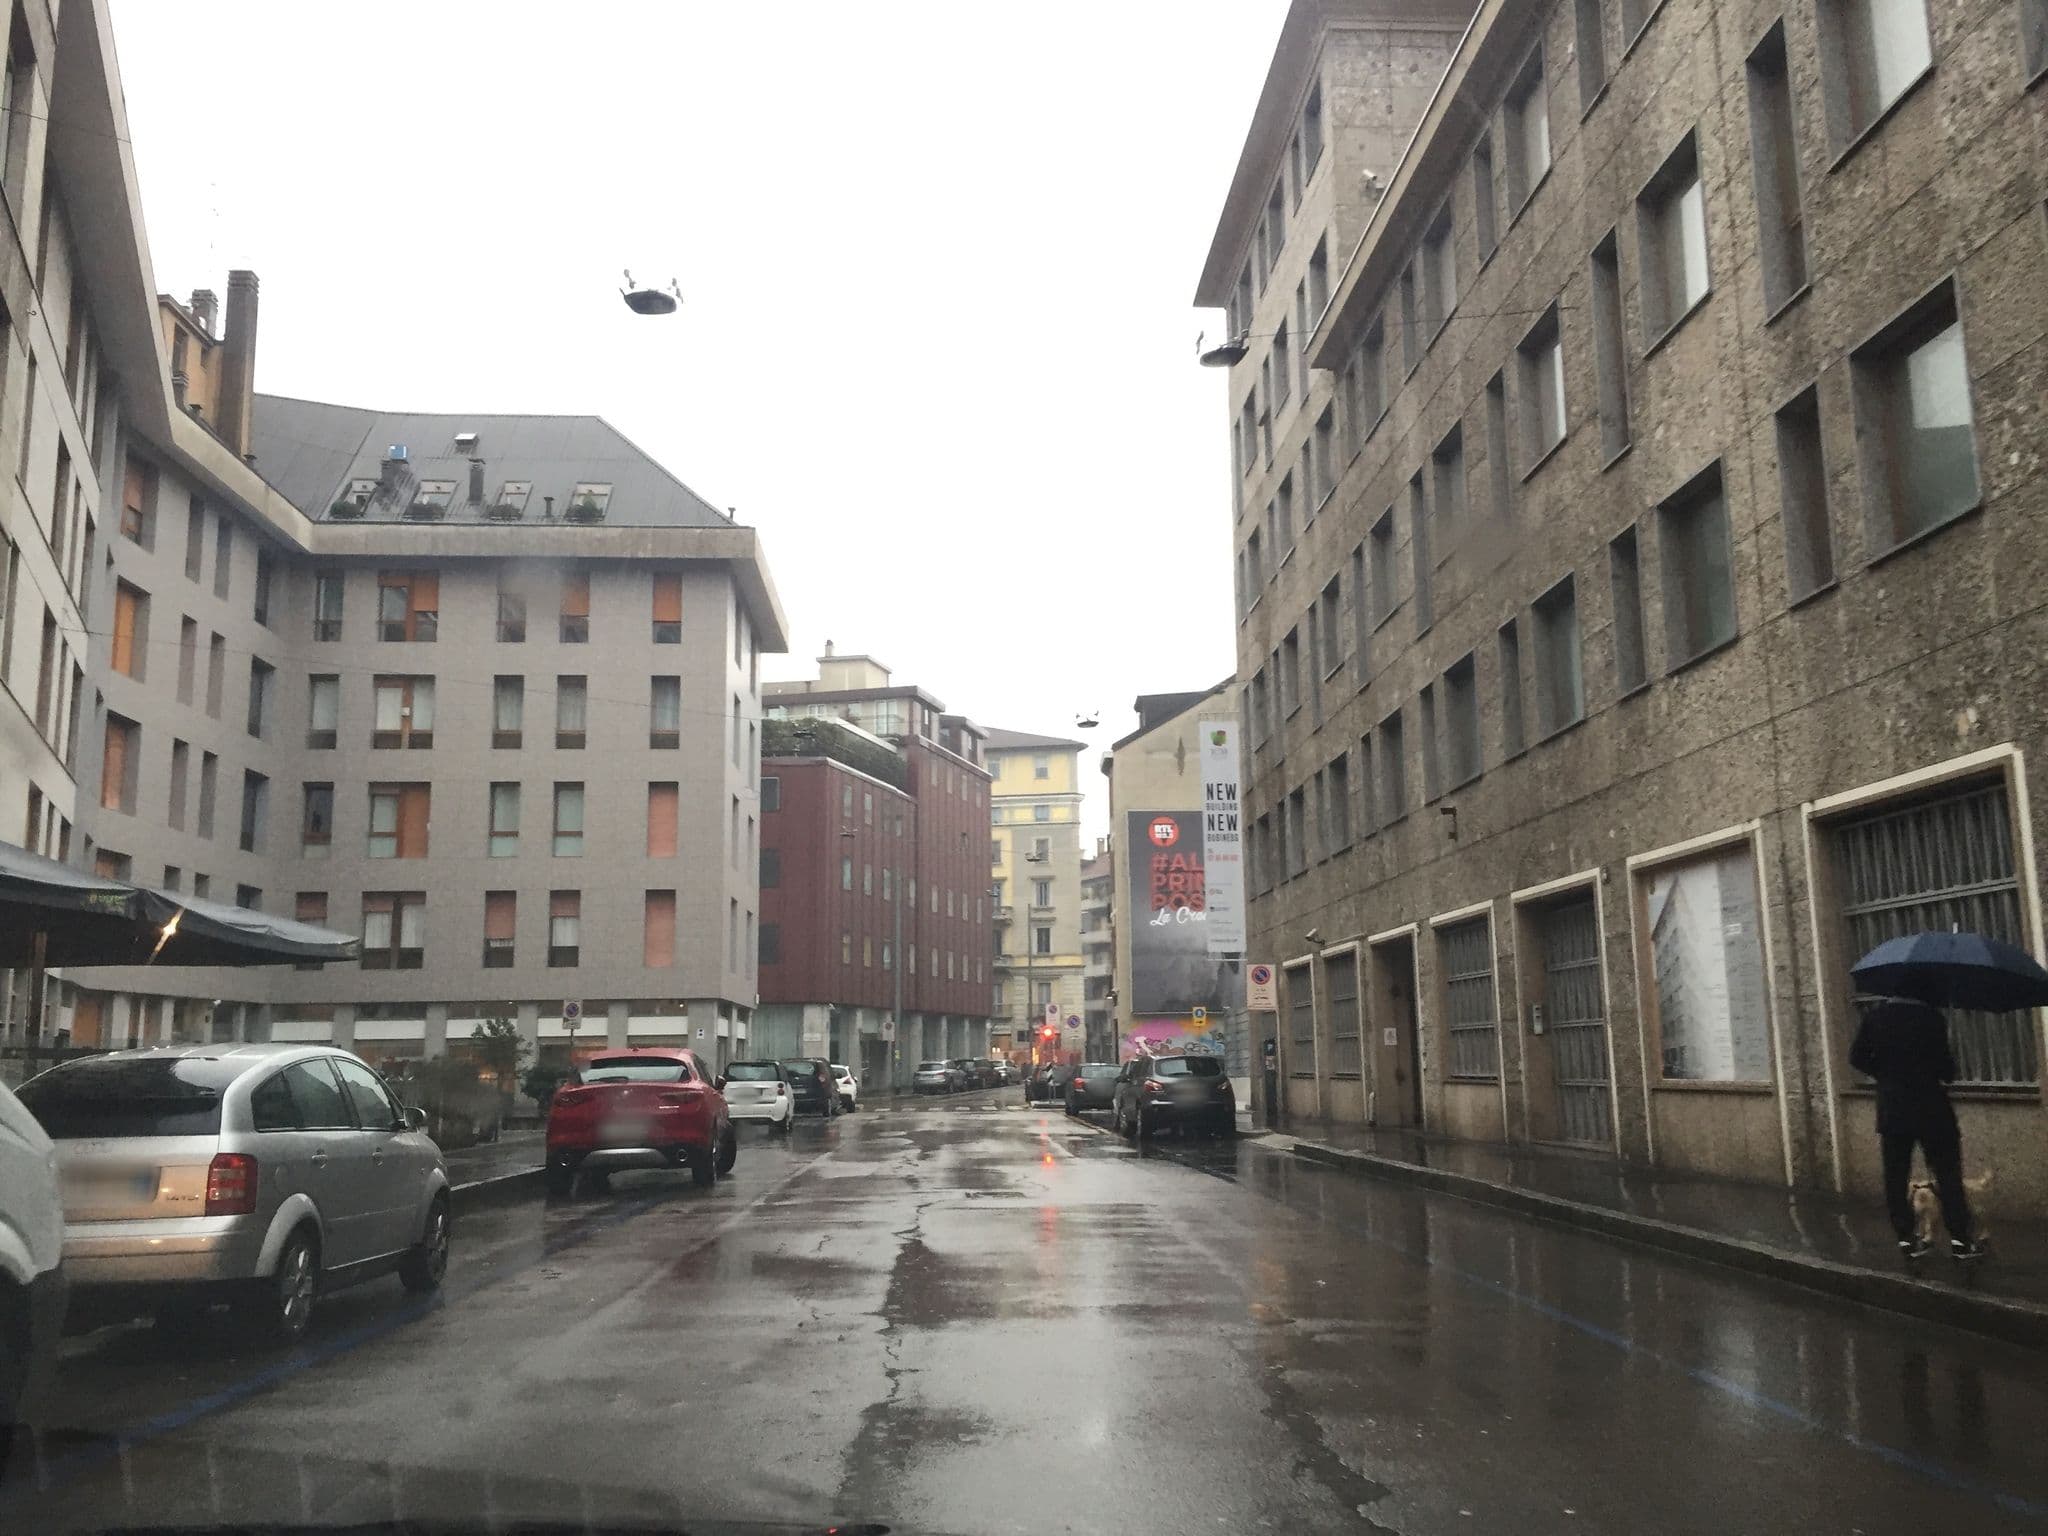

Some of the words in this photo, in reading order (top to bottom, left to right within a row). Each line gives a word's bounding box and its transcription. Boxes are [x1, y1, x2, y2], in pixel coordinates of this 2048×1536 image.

[1206, 783, 1237, 800] NEW
[1207, 814, 1238, 831] NEW
[1207, 833, 1239, 842] BUSINESS
[1150, 908, 1171, 926] La
